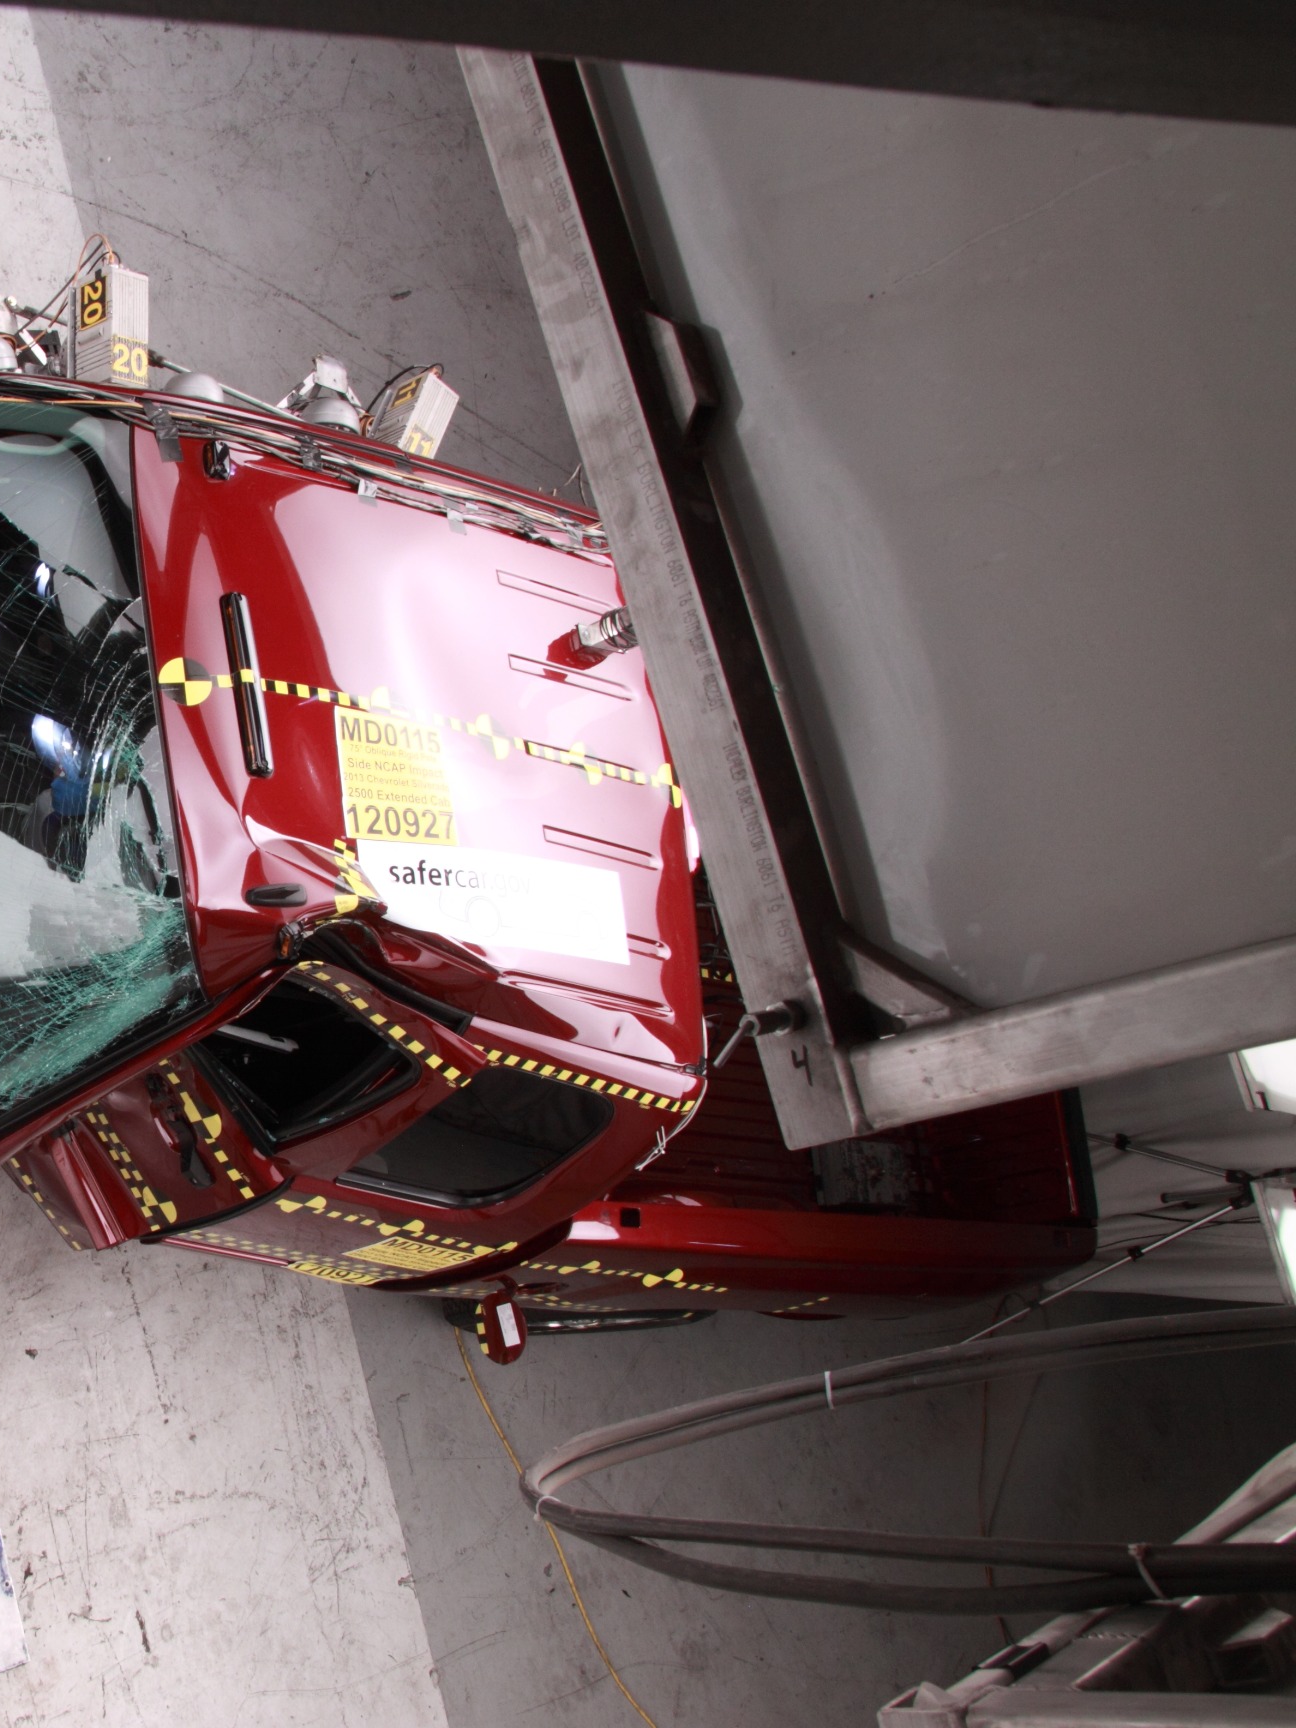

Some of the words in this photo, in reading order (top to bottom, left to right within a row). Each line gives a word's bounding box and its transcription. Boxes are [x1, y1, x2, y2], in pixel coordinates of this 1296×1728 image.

[537, 138, 559, 174] ASTM
[562, 216, 581, 241] LOT
[83, 281, 103, 325] 20
[112, 343, 148, 377] 20
[408, 432, 433, 459] 11
[612, 378, 644, 456] INDALEX
[638, 461, 675, 555] BURLINGTON
[678, 590, 694, 606] T6
[340, 715, 440, 753] MD0115
[344, 772, 364, 783] 2013
[366, 774, 410, 786] Chevrolet
[347, 757, 372, 769] Side
[374, 761, 406, 773] NCAP
[409, 765, 443, 778] Impact
[348, 787, 374, 799] 2500
[377, 789, 428, 805] Extended
[346, 803, 455, 840] 120927
[775, 918, 798, 956] ASTM
[791, 1044, 813, 1087] 4
[382, 1238, 473, 1262] MD0115
